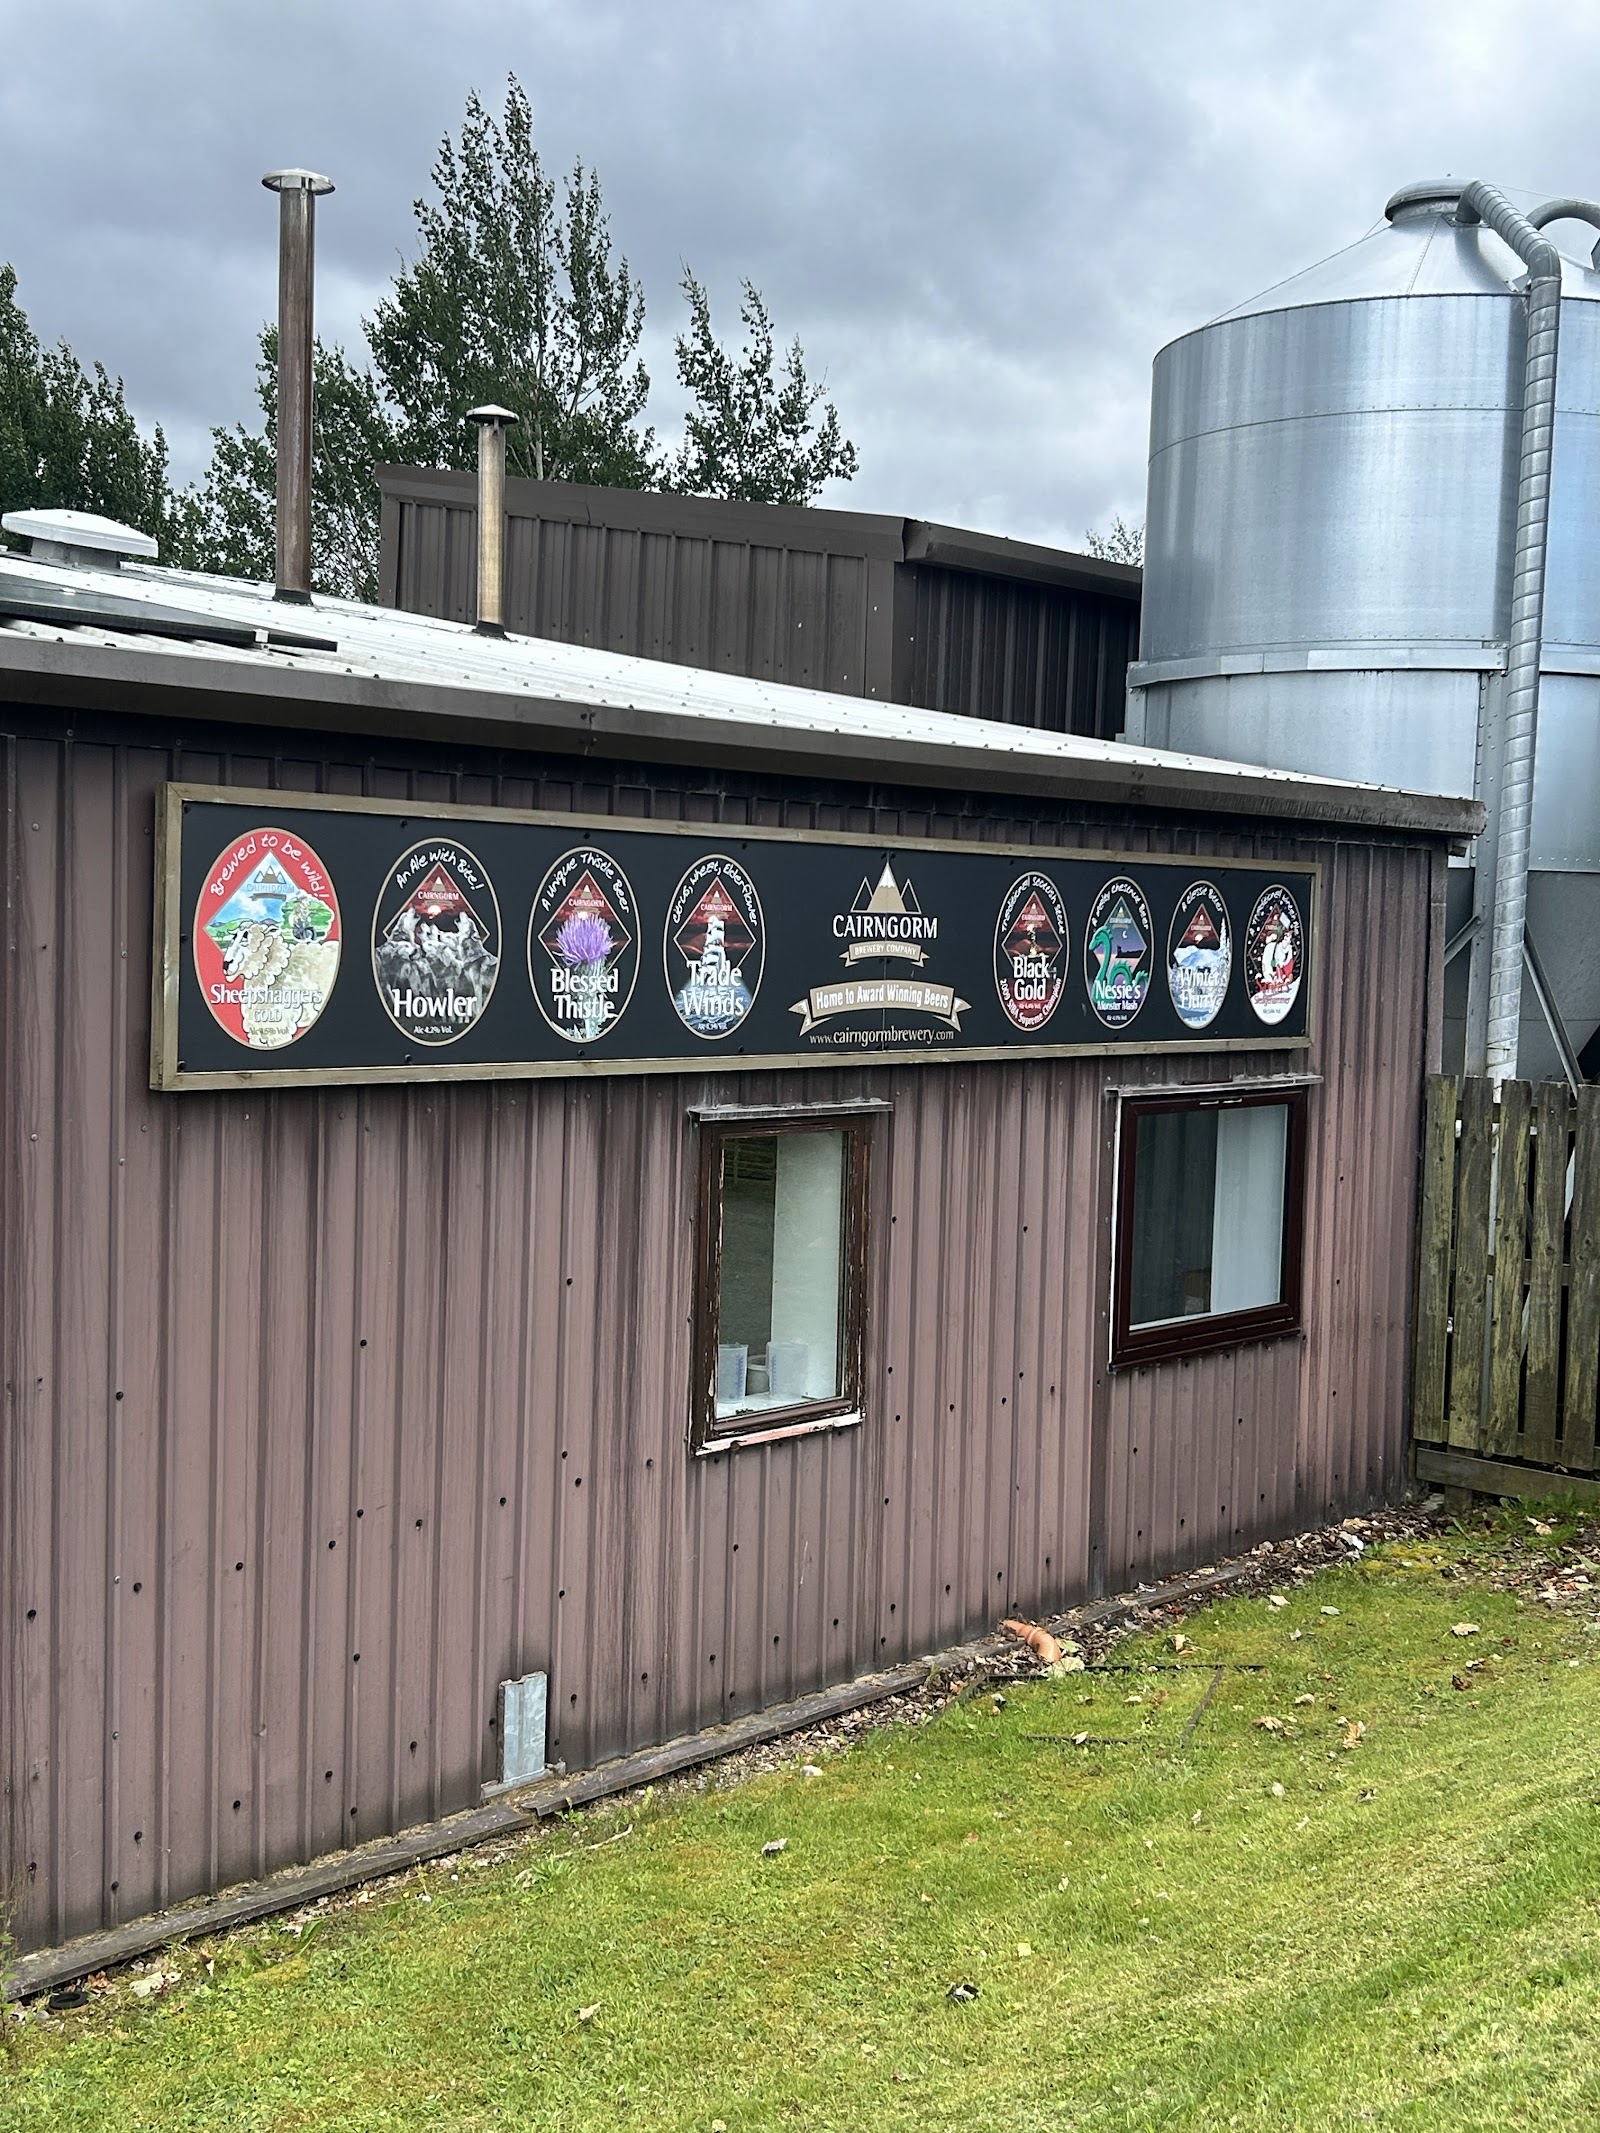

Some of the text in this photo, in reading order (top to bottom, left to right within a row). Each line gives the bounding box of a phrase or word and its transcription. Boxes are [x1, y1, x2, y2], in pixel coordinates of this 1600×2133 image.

[210, 834, 330, 898] Brewed to be wild!
[396, 870, 411, 889] An
[410, 854, 428, 873] Ale
[457, 858, 485, 890] Bite!
[417, 891, 459, 900] CAIRNGORM
[541, 898, 551, 911] A
[580, 852, 614, 879] Thistle
[612, 879, 629, 913] Beer
[832, 914, 938, 939] CAIRNGORM
[854, 943, 917, 956] BREWERY COMPANY
[686, 960, 742, 987] Trade
[1013, 955, 1051, 978] Black
[1179, 966, 1221, 987] Winter
[550, 967, 618, 993] Blessed
[1014, 978, 1046, 1000] Gold
[1095, 979, 1141, 1000] Nessie's
[210, 983, 322, 1009] Sheepshaggers
[392, 988, 478, 1018] Howler
[553, 993, 617, 1019] Thistle
[680, 989, 745, 1016] Winds
[816, 984, 949, 1010] Home to Award Winning Beers
[254, 1009, 283, 1022] GOLD
[809, 1025, 954, 1048] www.cairngormbrewery.com
